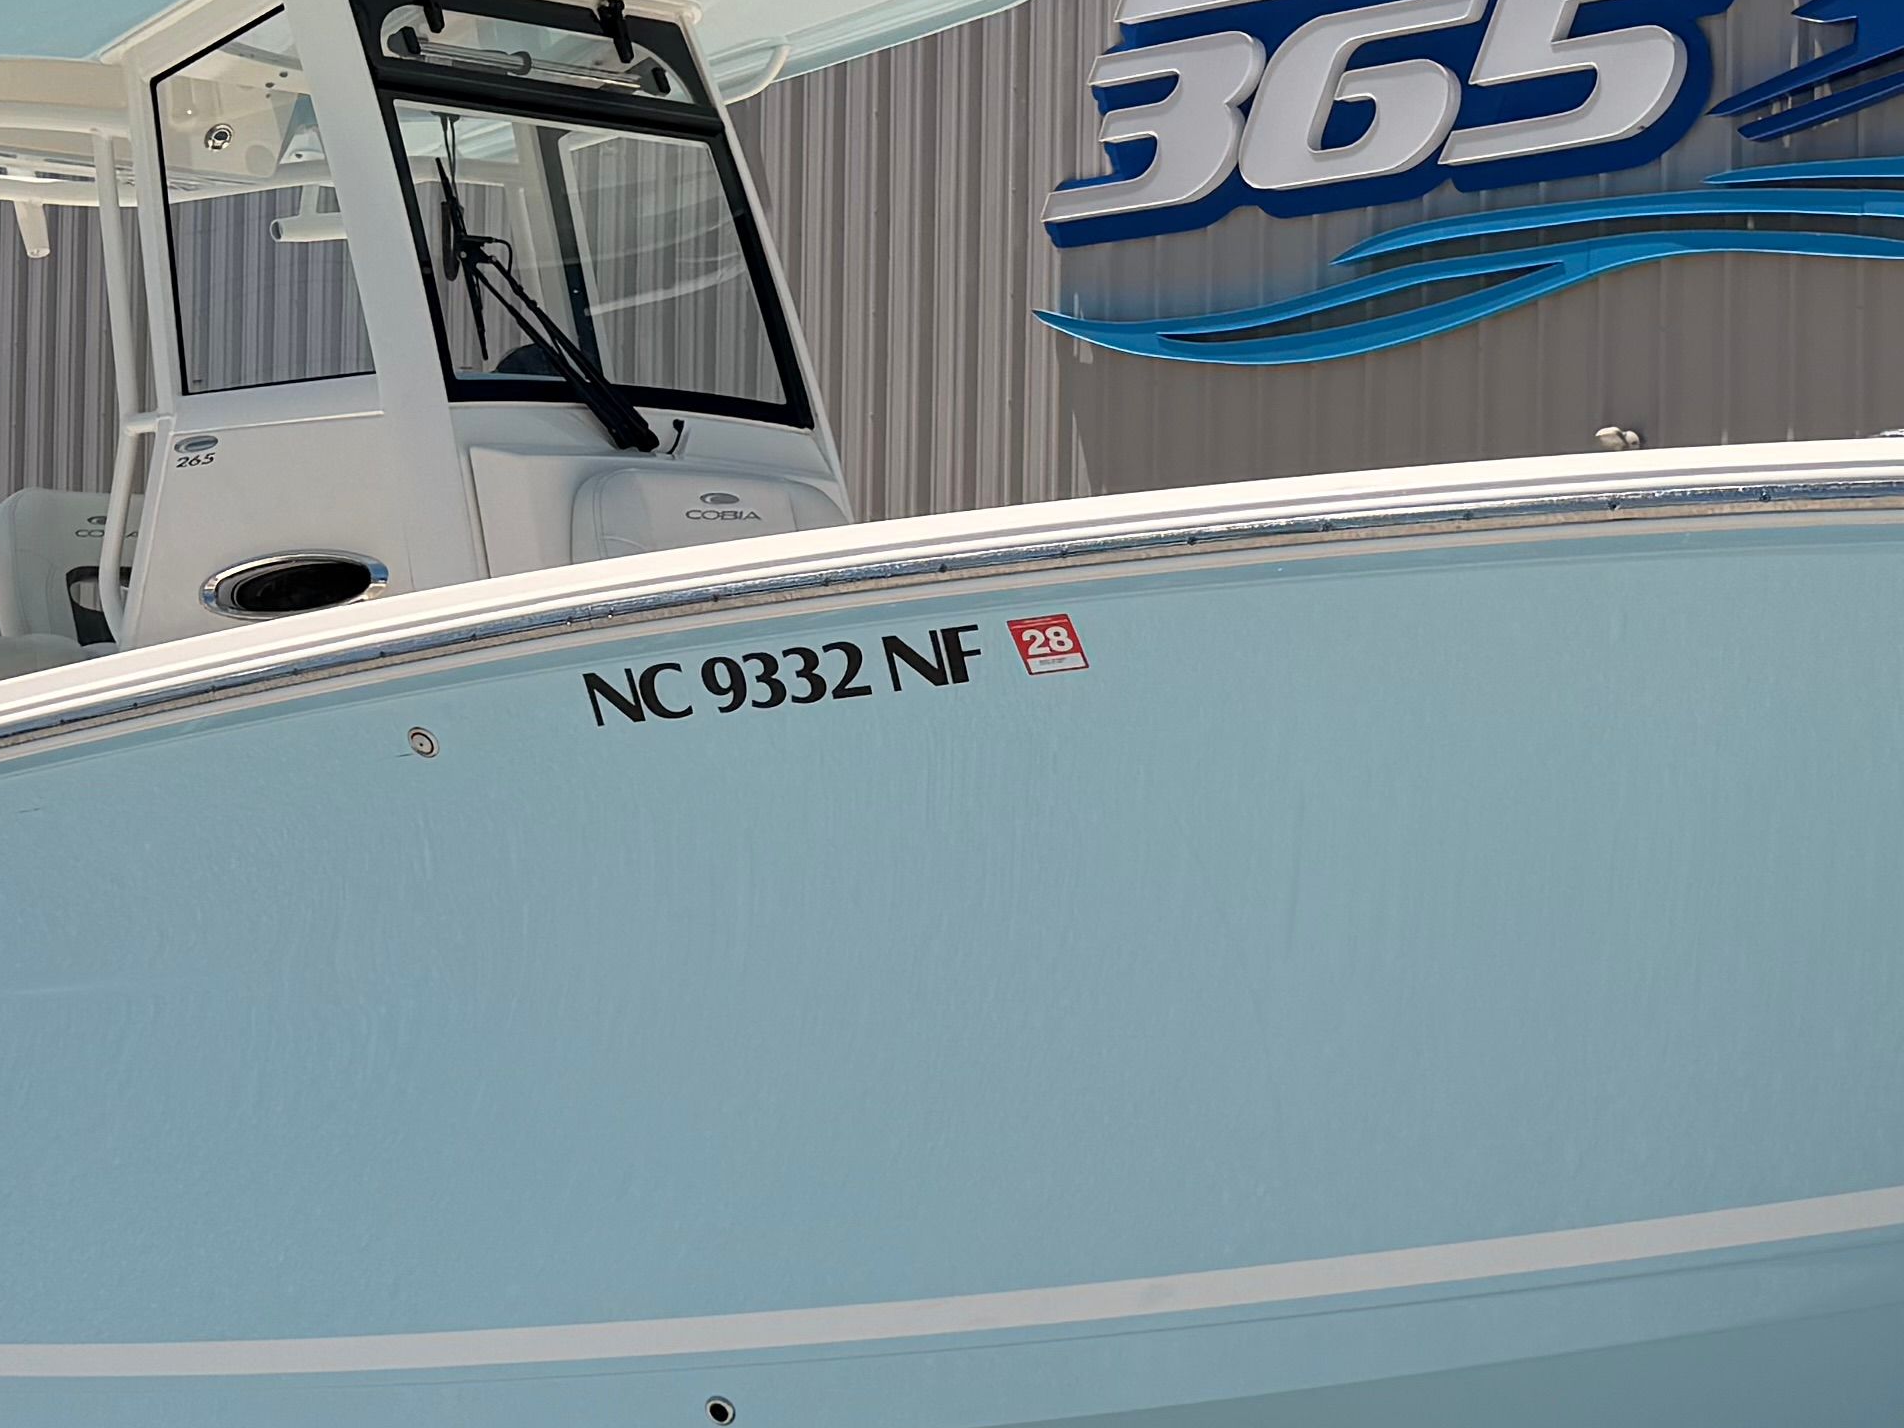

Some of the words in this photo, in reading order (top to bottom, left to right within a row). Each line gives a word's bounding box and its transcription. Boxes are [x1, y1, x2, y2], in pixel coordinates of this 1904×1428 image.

[176, 452, 216, 468] 265
[685, 509, 762, 521] COBIA
[75, 529, 139, 538] COA
[1021, 625, 1074, 656] 28
[582, 661, 693, 727] NC
[701, 641, 873, 713] 9332
[881, 624, 983, 692] NF
